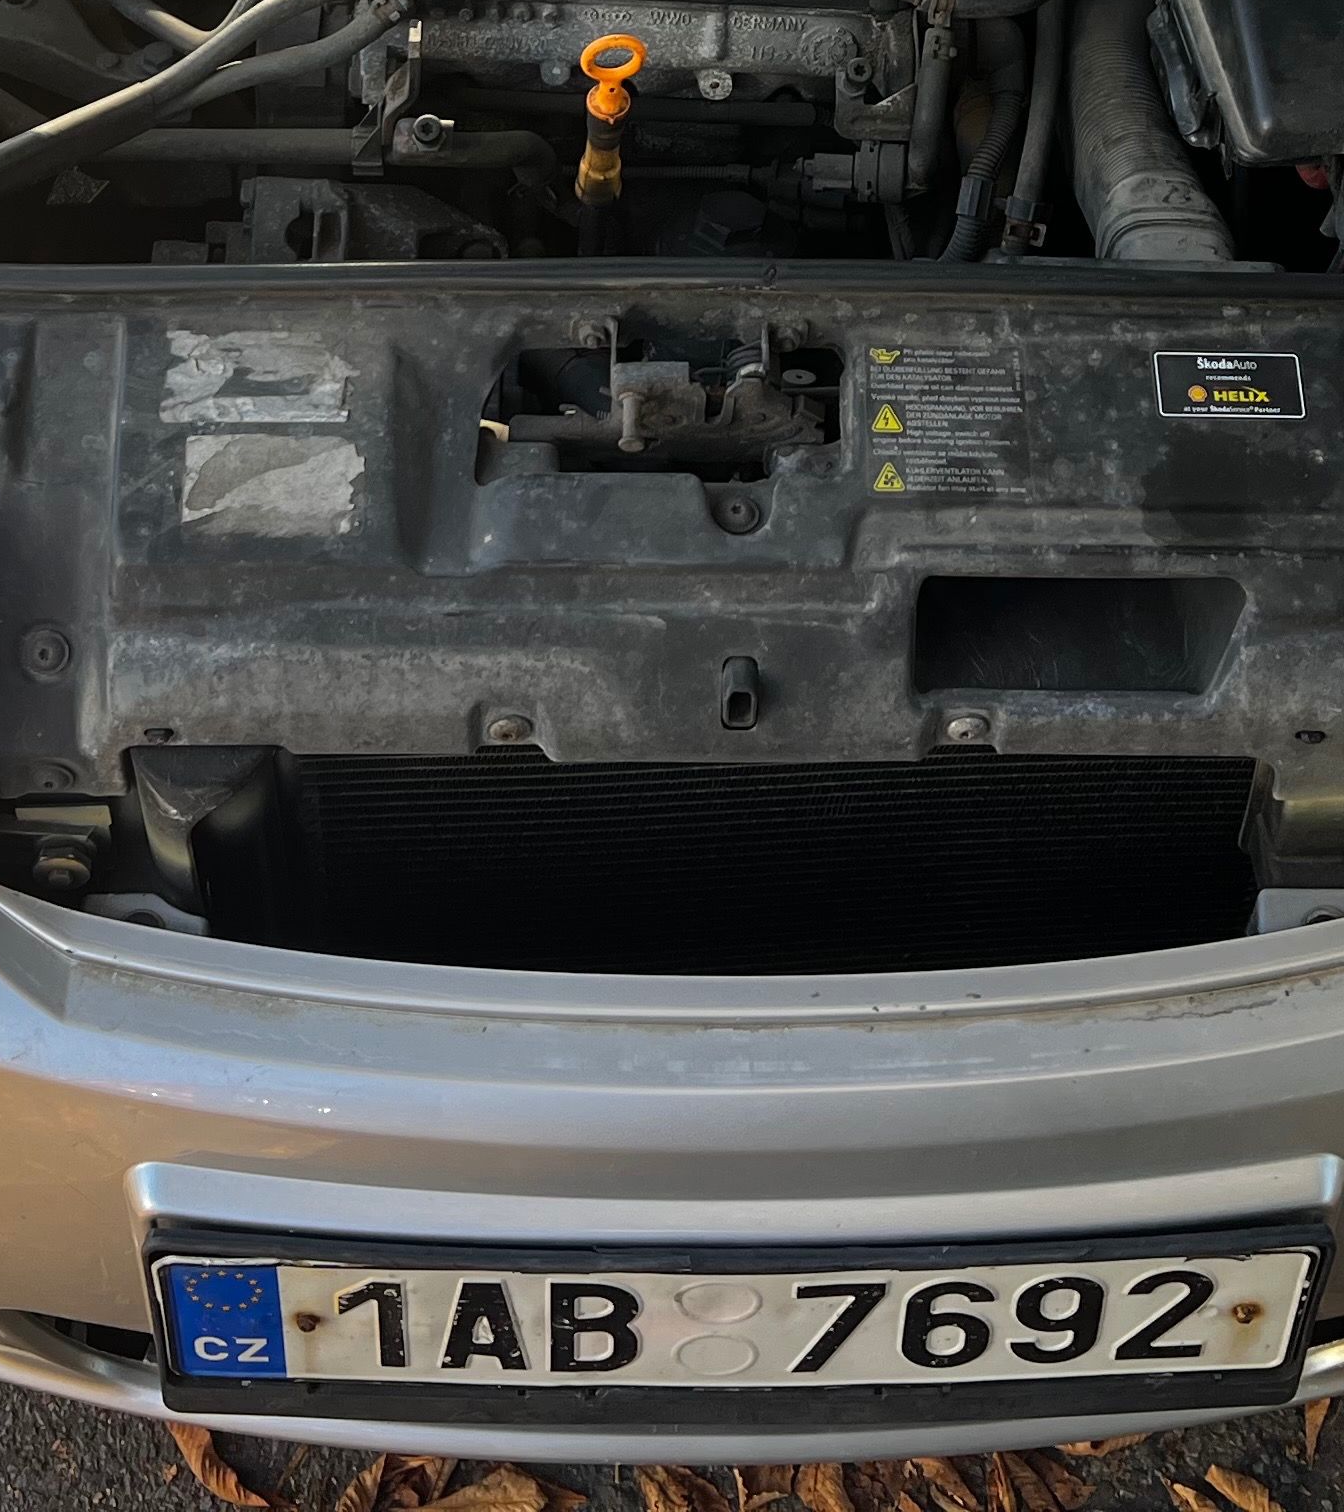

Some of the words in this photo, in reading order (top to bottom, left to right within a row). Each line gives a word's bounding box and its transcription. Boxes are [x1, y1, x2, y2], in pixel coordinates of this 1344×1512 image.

[1196, 356, 1258, 370] ŠkodaAuto
[1205, 374, 1252, 382] recommends
[1213, 389, 1271, 403] HELIX
[1192, 406, 1209, 414] your
[1254, 406, 1282, 414] Partner
[336, 1279, 642, 1373] 1AB
[791, 1269, 1217, 1374] 7692
[193, 1335, 271, 1364] CZ
